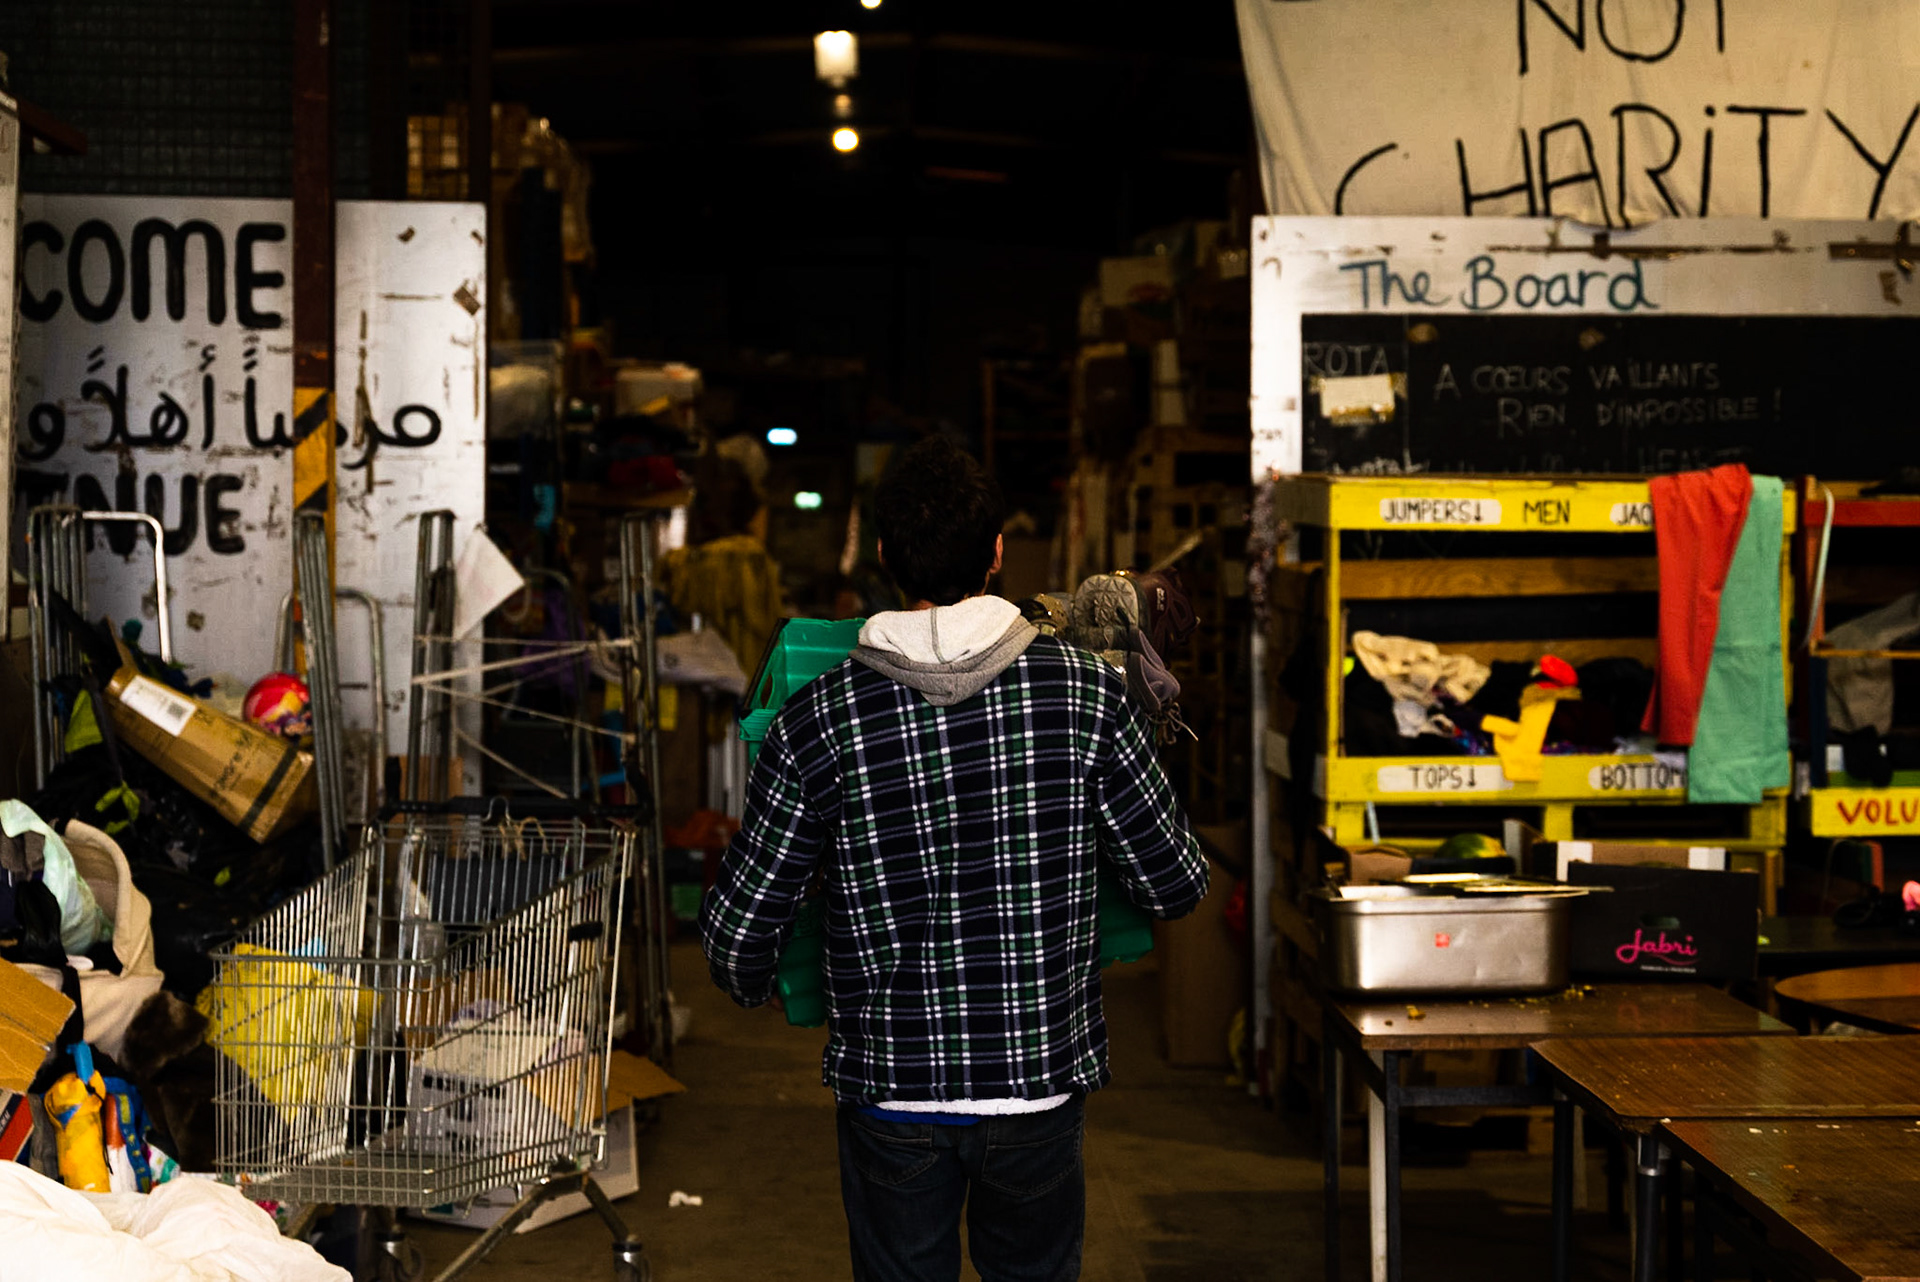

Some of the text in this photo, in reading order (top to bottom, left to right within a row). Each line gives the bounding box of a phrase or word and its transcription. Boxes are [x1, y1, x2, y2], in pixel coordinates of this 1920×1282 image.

[20, 218, 285, 328] COME
[1339, 255, 1661, 311] The Board
[1302, 342, 1390, 379] ROTA
[1432, 362, 1462, 402] A
[1384, 499, 1472, 523] JUMPERS
[1523, 500, 1572, 525] MEN
[1408, 765, 1463, 790] TOPS
[1836, 798, 1919, 826] VOLU
